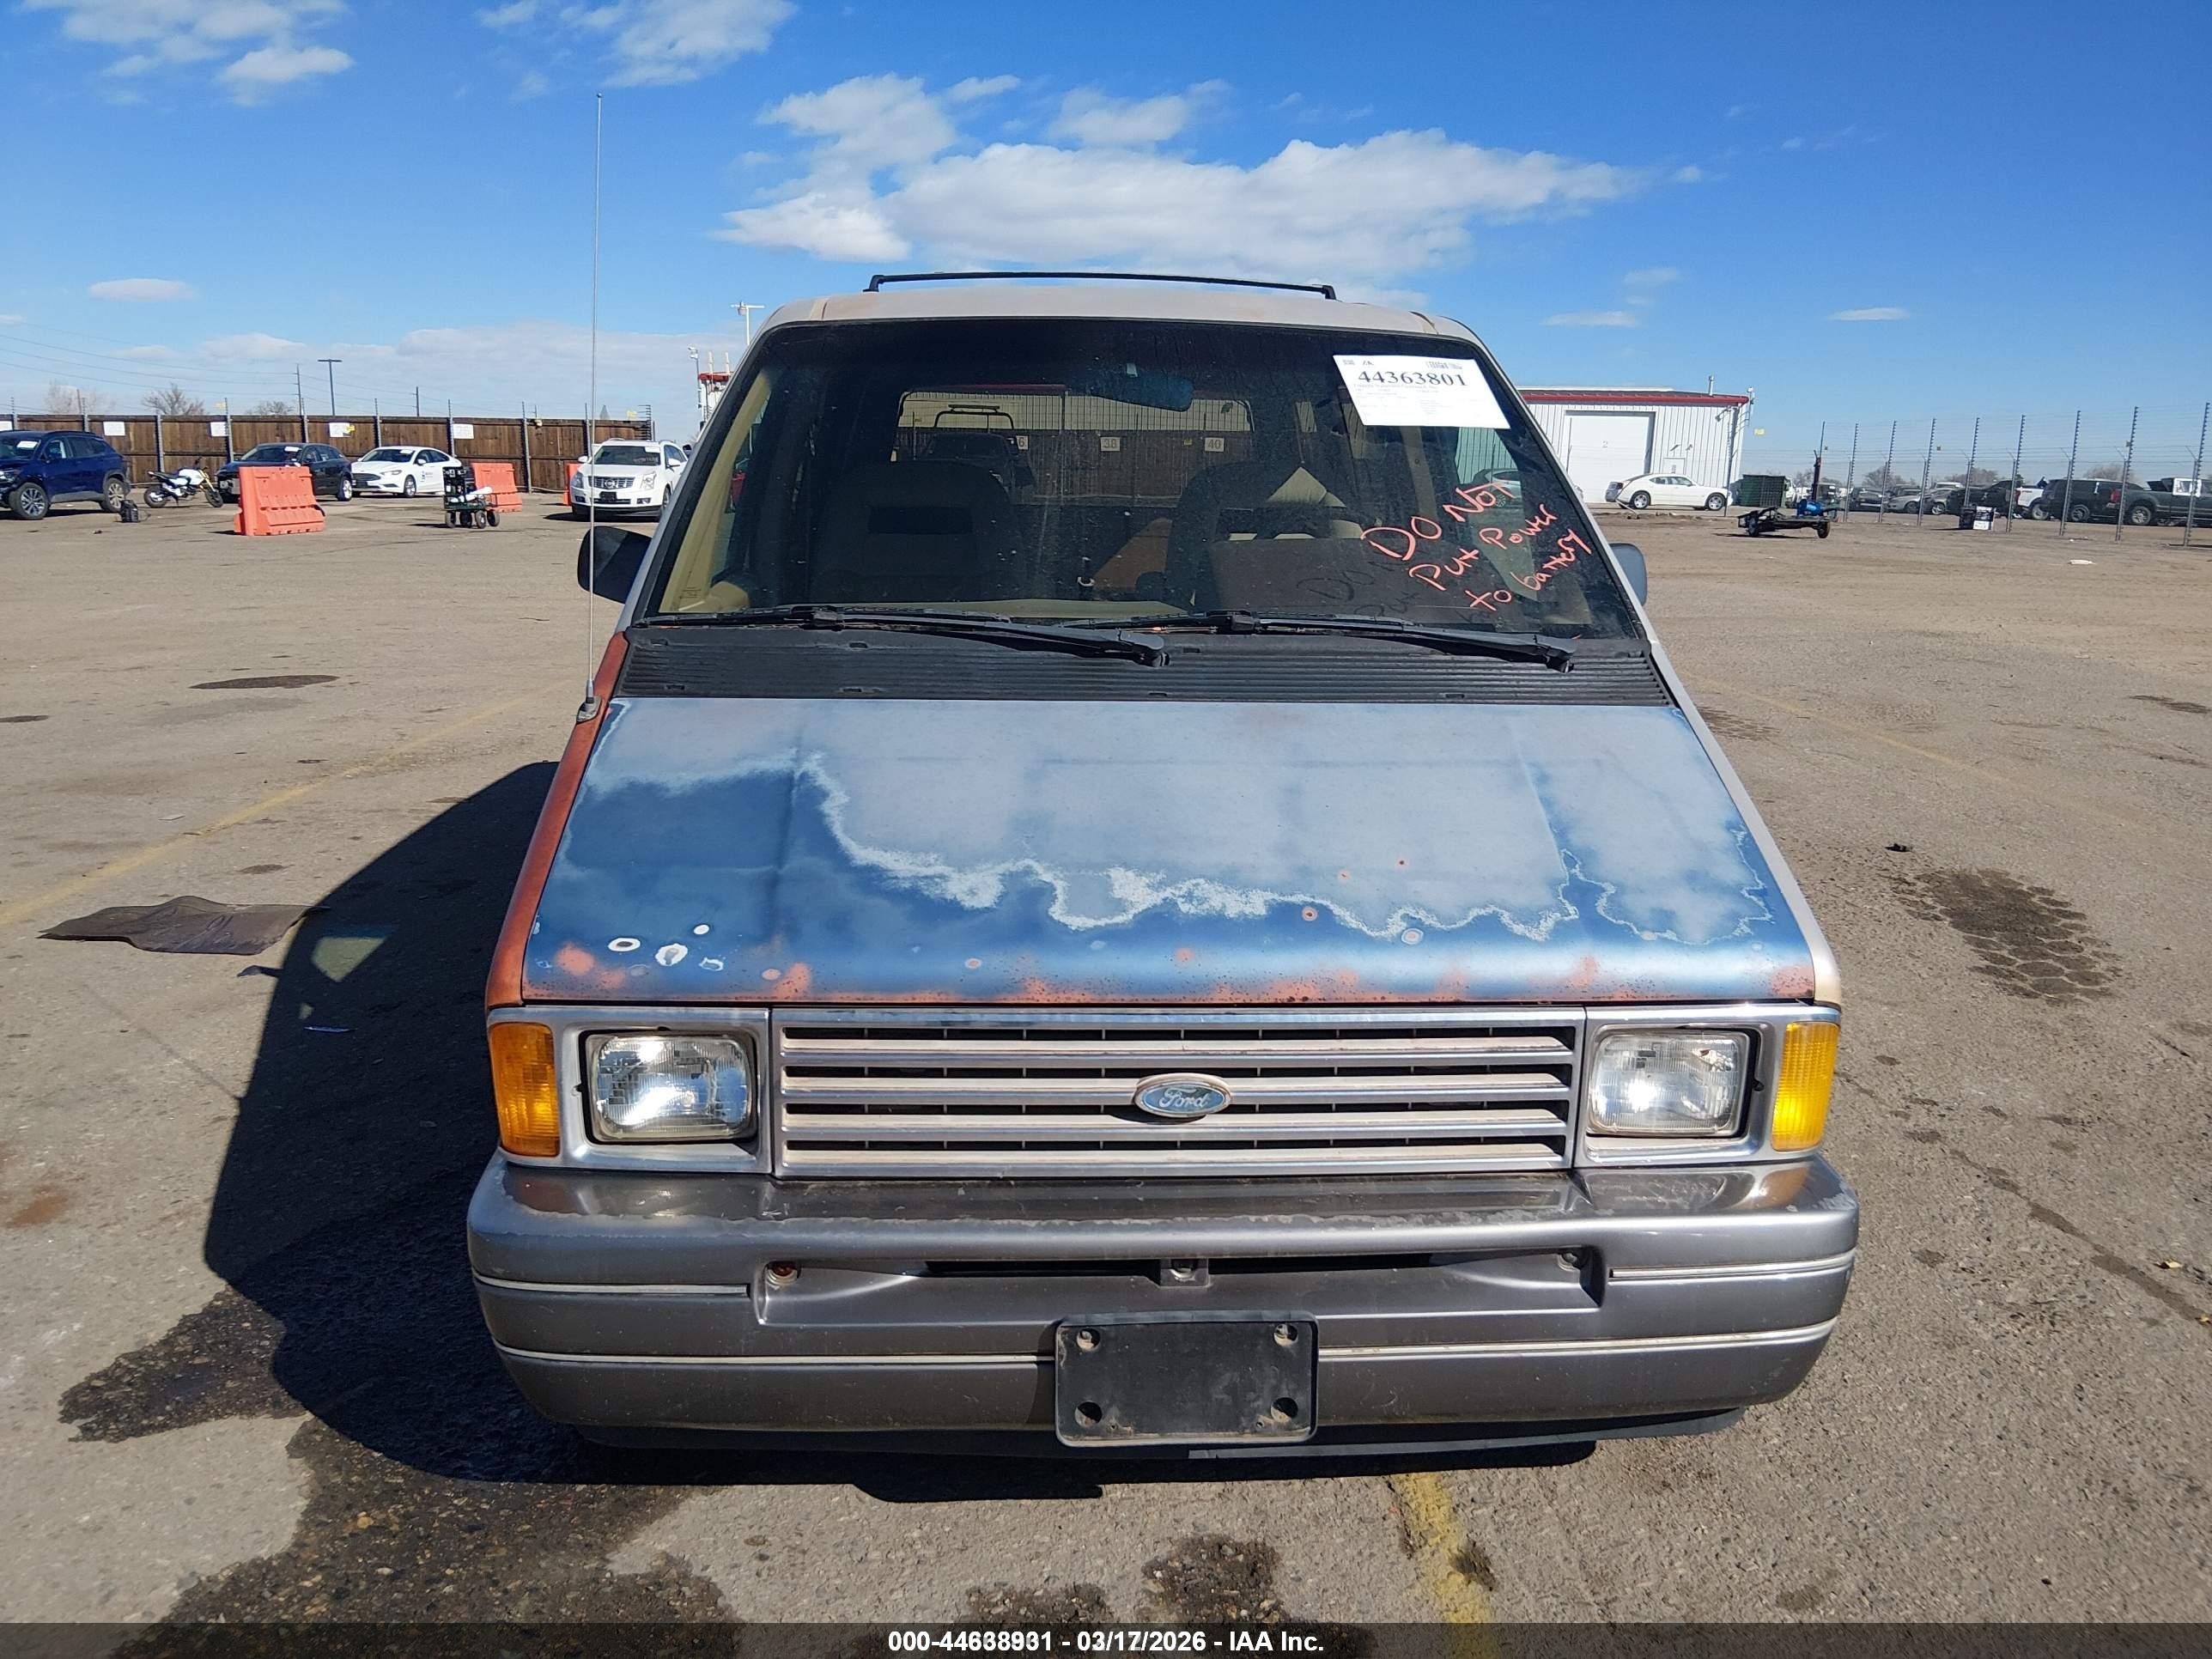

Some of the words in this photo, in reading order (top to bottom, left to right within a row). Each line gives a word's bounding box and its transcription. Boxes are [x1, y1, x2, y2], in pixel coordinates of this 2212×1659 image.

[1358, 370, 1468, 386] 44363801
[1207, 439, 1221, 449] 40
[1360, 516, 1442, 561] DO
[1158, 1087, 1211, 1108] Ford
